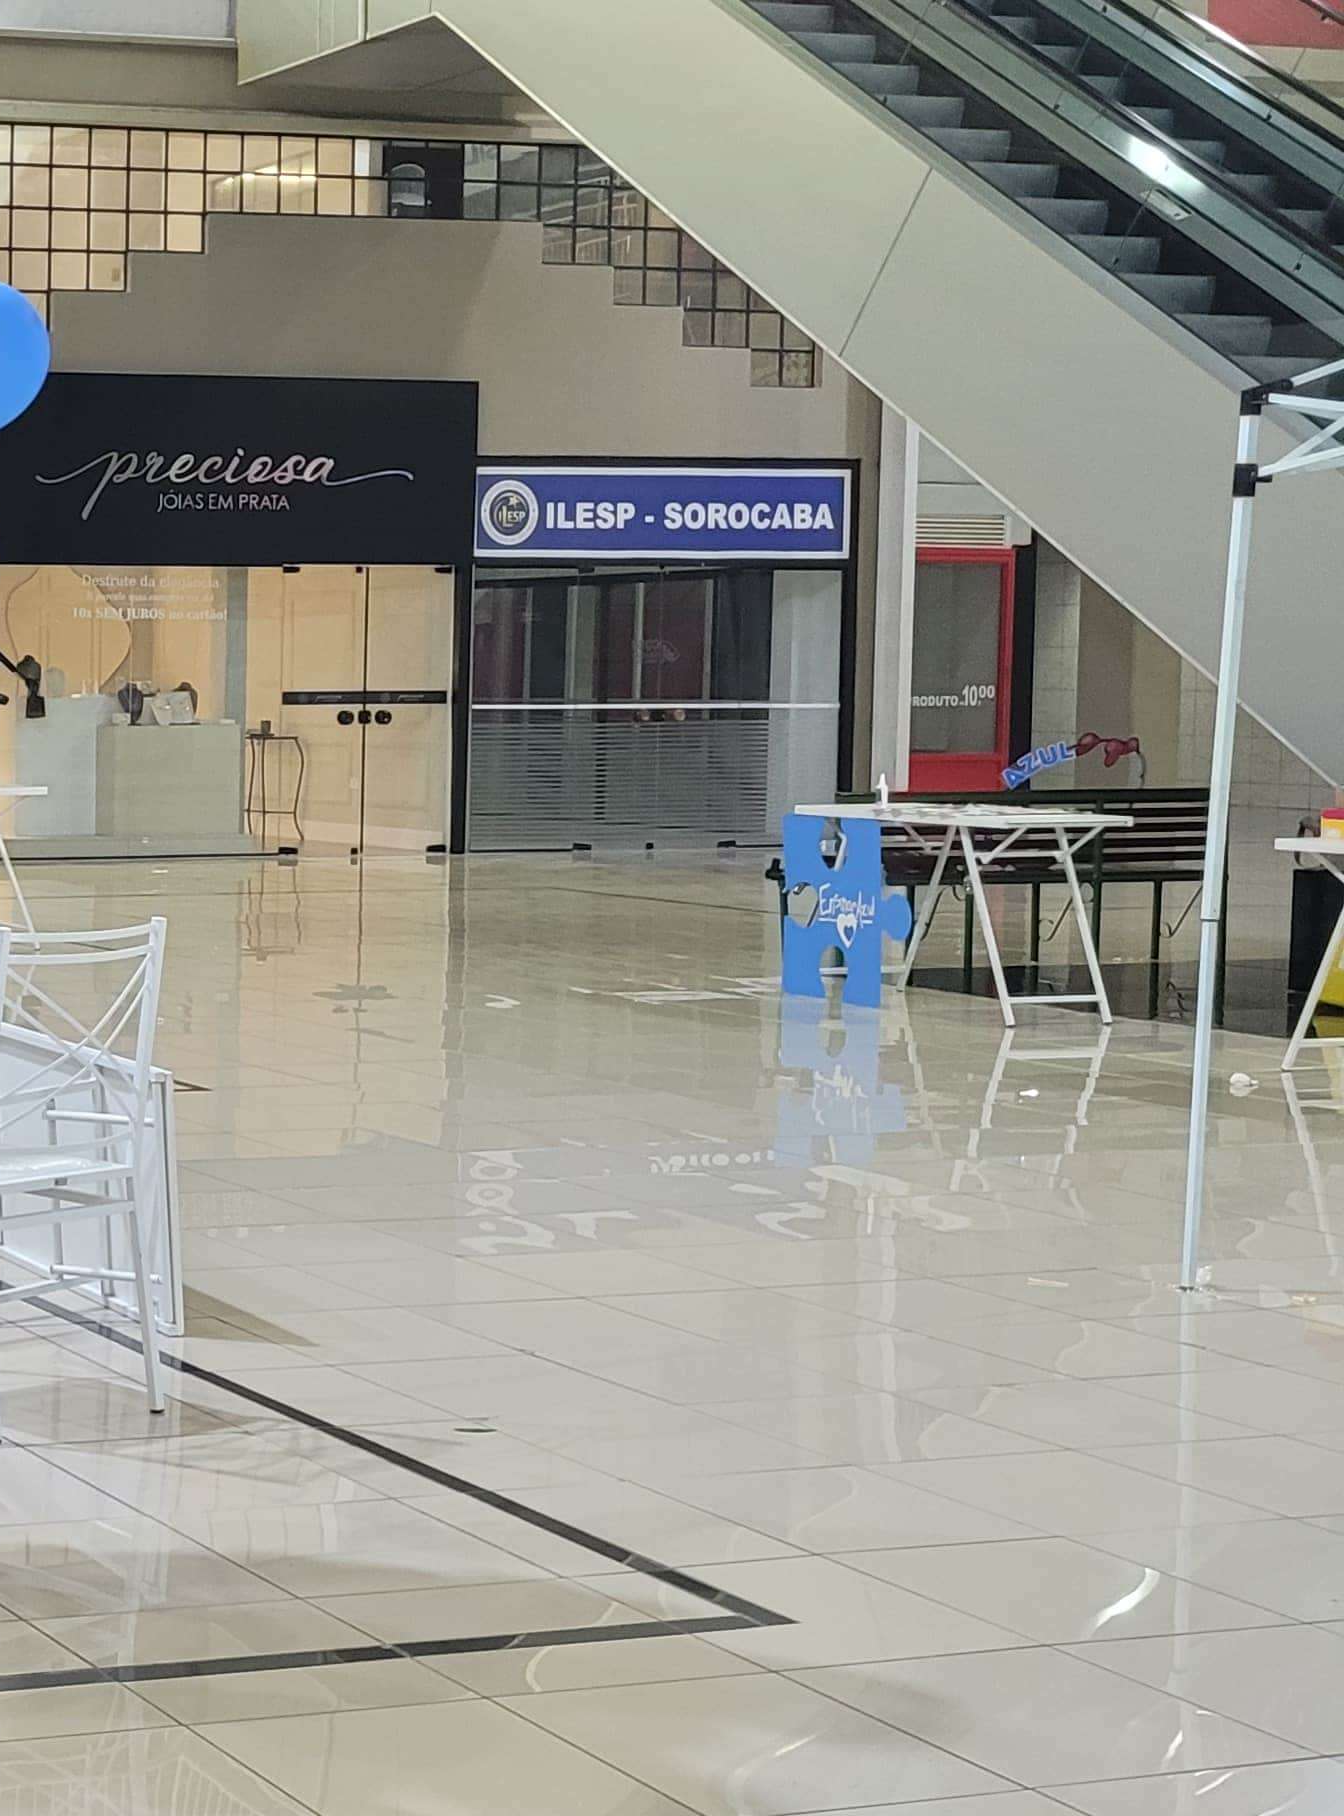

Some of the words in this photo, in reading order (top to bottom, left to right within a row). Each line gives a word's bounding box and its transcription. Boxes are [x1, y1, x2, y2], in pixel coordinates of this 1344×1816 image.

[35, 448, 414, 520] preciosa
[157, 489, 204, 512] JÓIAS
[208, 494, 234, 511] EM
[239, 493, 290, 511] PRATA
[546, 502, 635, 529] ILESP
[644, 514, 655, 523] -
[663, 502, 835, 530] SOROCABA
[126, 607, 166, 621] JUROS
[912, 696, 959, 706] RODUTO
[1002, 741, 1076, 789] AZUL
